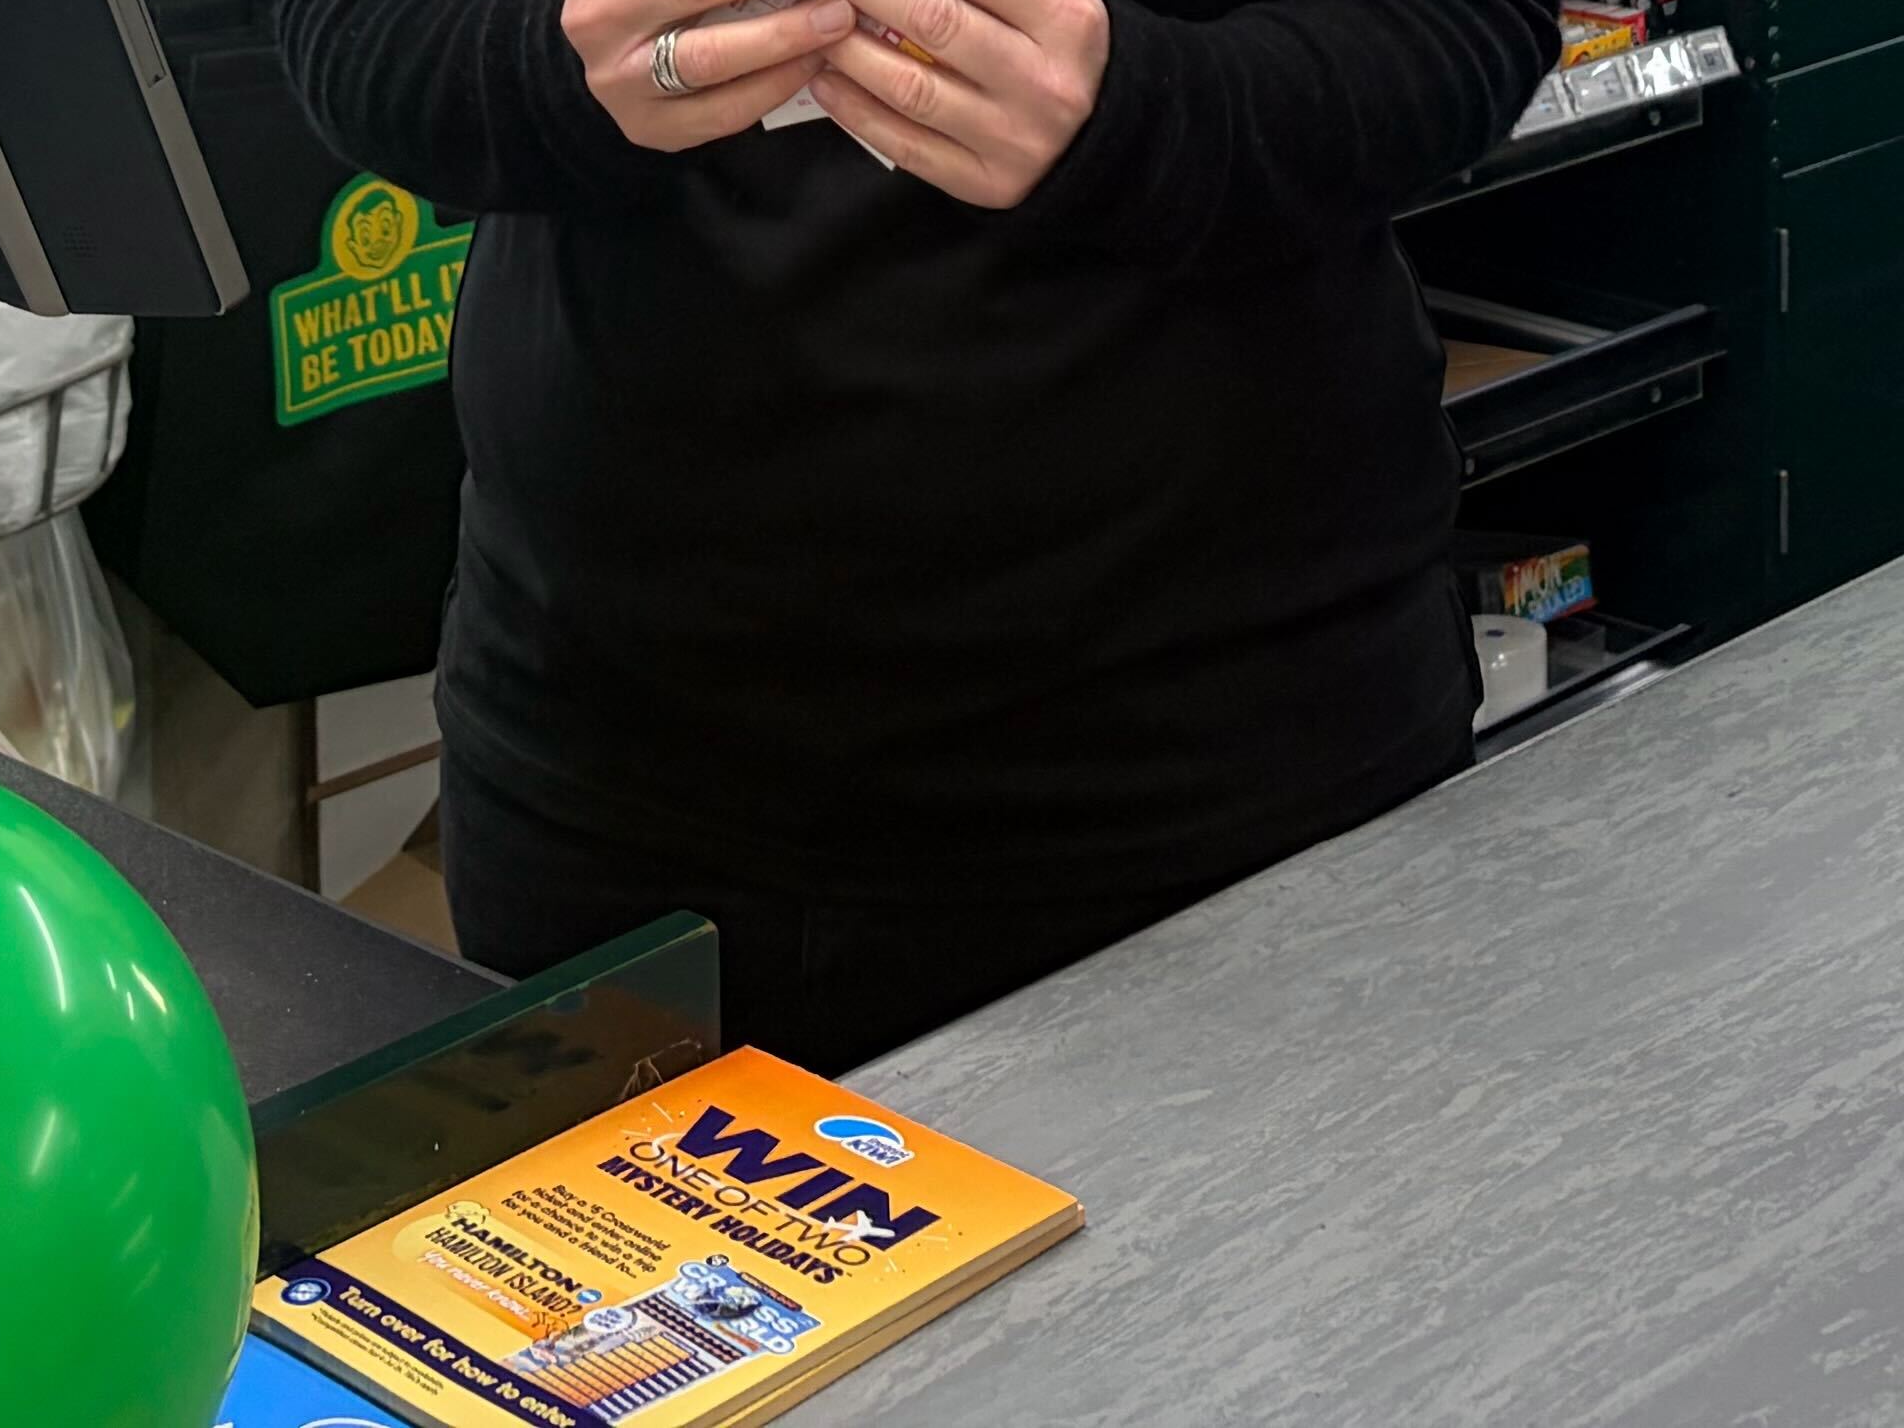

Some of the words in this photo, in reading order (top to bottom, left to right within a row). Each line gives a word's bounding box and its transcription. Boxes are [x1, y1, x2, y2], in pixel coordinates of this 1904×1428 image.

[292, 272, 432, 348] WHAT'LL
[300, 344, 341, 394] BE
[347, 312, 454, 374] TODAY
[597, 1155, 723, 1222] MYSTERY
[709, 1215, 846, 1285] HOLIDAYS
[629, 1142, 721, 1192] ONE
[714, 1186, 781, 1217] OF
[775, 1213, 871, 1266] TWO
[675, 1105, 942, 1252] WIN
[425, 1227, 515, 1278] HAMILTON
[504, 1272, 583, 1318] ISLAND?
[451, 1218, 582, 1293] HAMILTON
[338, 1285, 383, 1318] Turn
[380, 1311, 426, 1344] over
[423, 1338, 456, 1363] for
[451, 1357, 498, 1387] how
[495, 1382, 520, 1400] to
[519, 1396, 576, 1428] enter
